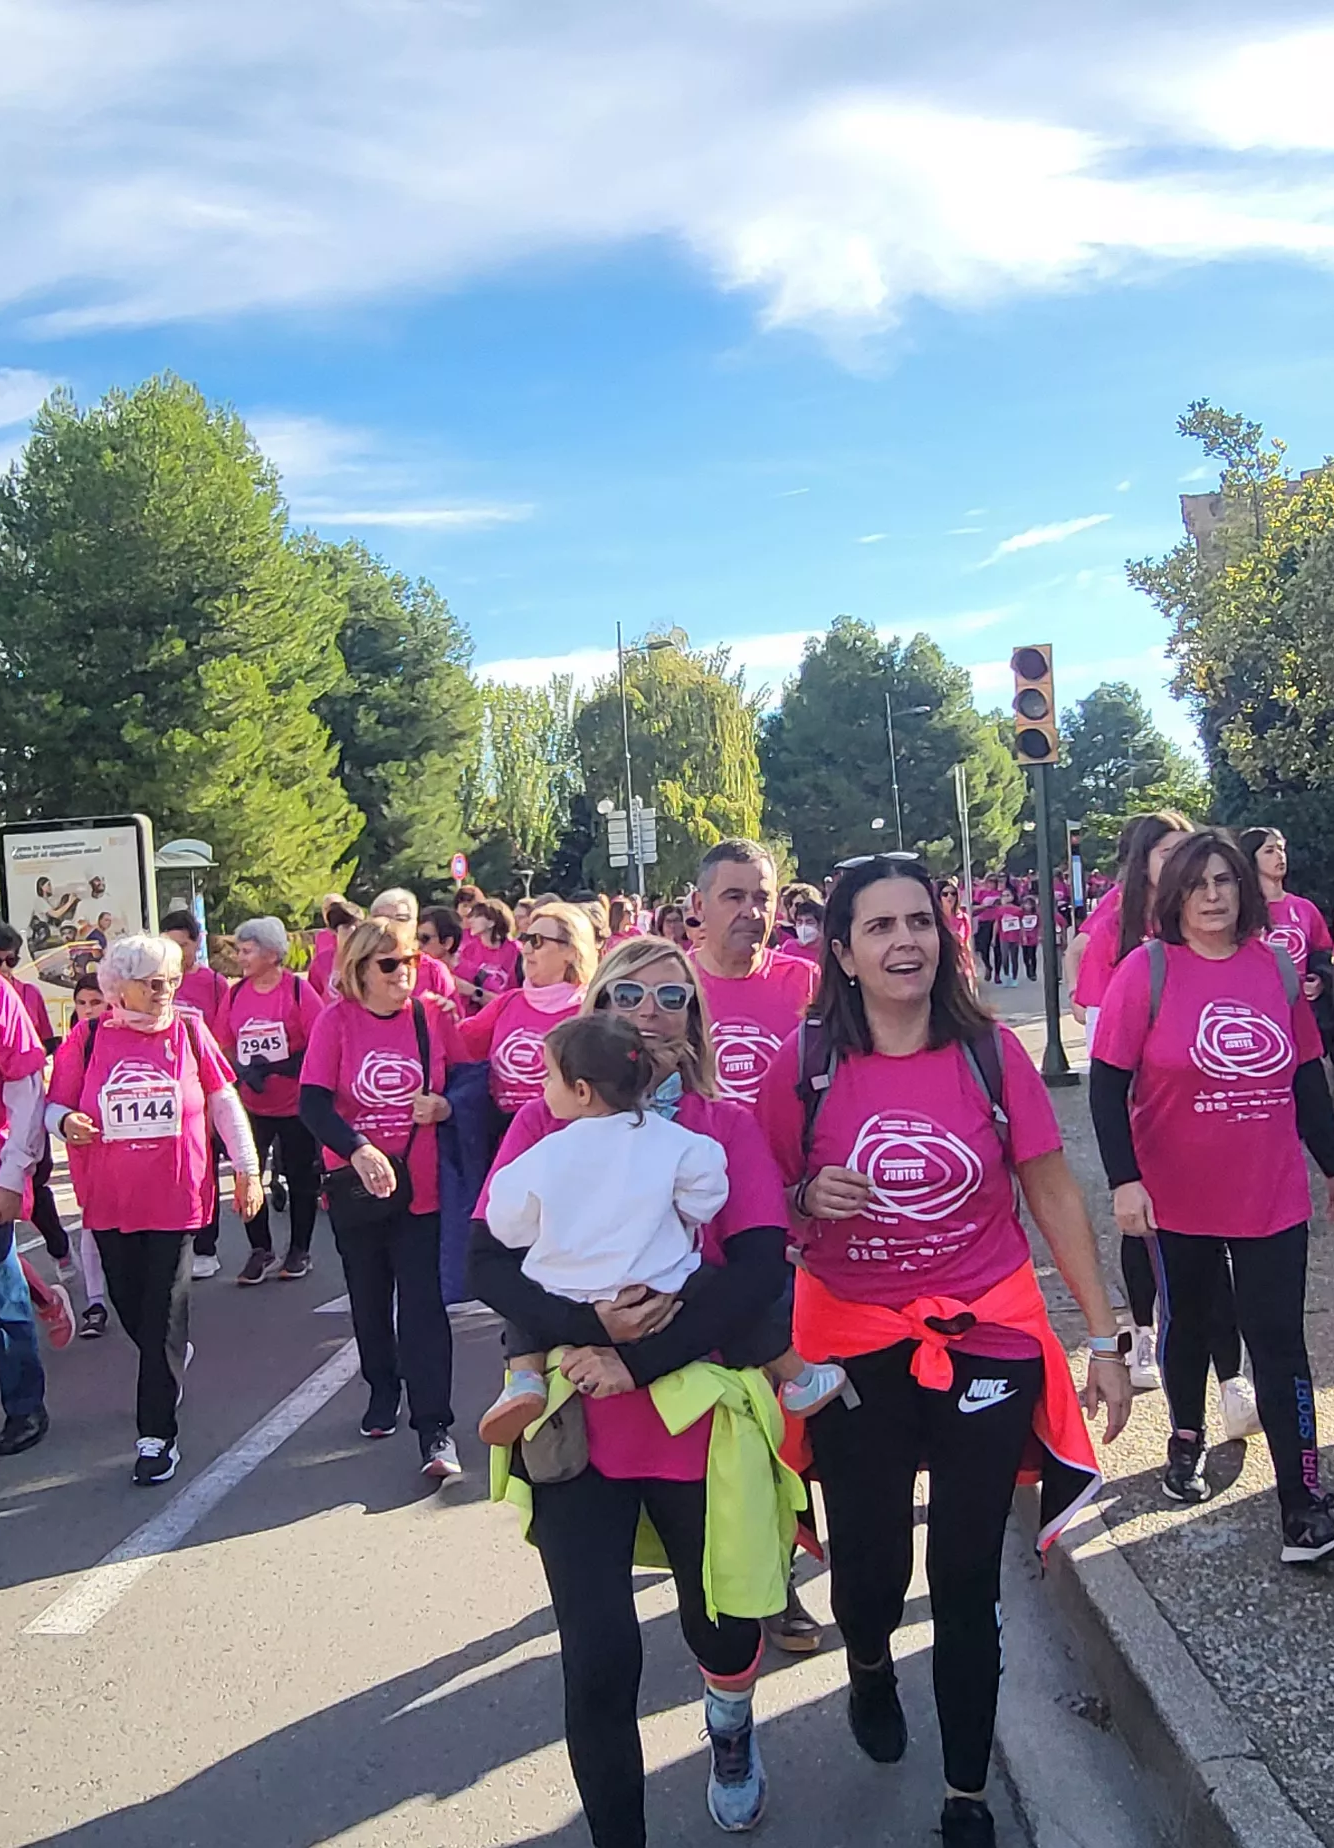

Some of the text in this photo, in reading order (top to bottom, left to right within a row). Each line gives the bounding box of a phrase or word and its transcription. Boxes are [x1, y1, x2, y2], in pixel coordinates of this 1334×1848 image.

[240, 1036, 282, 1055] 2945
[110, 1099, 175, 1123] 1144
[967, 1378, 1009, 1399] NIKE
[1294, 1375, 1317, 1489] GIRL SPORT
